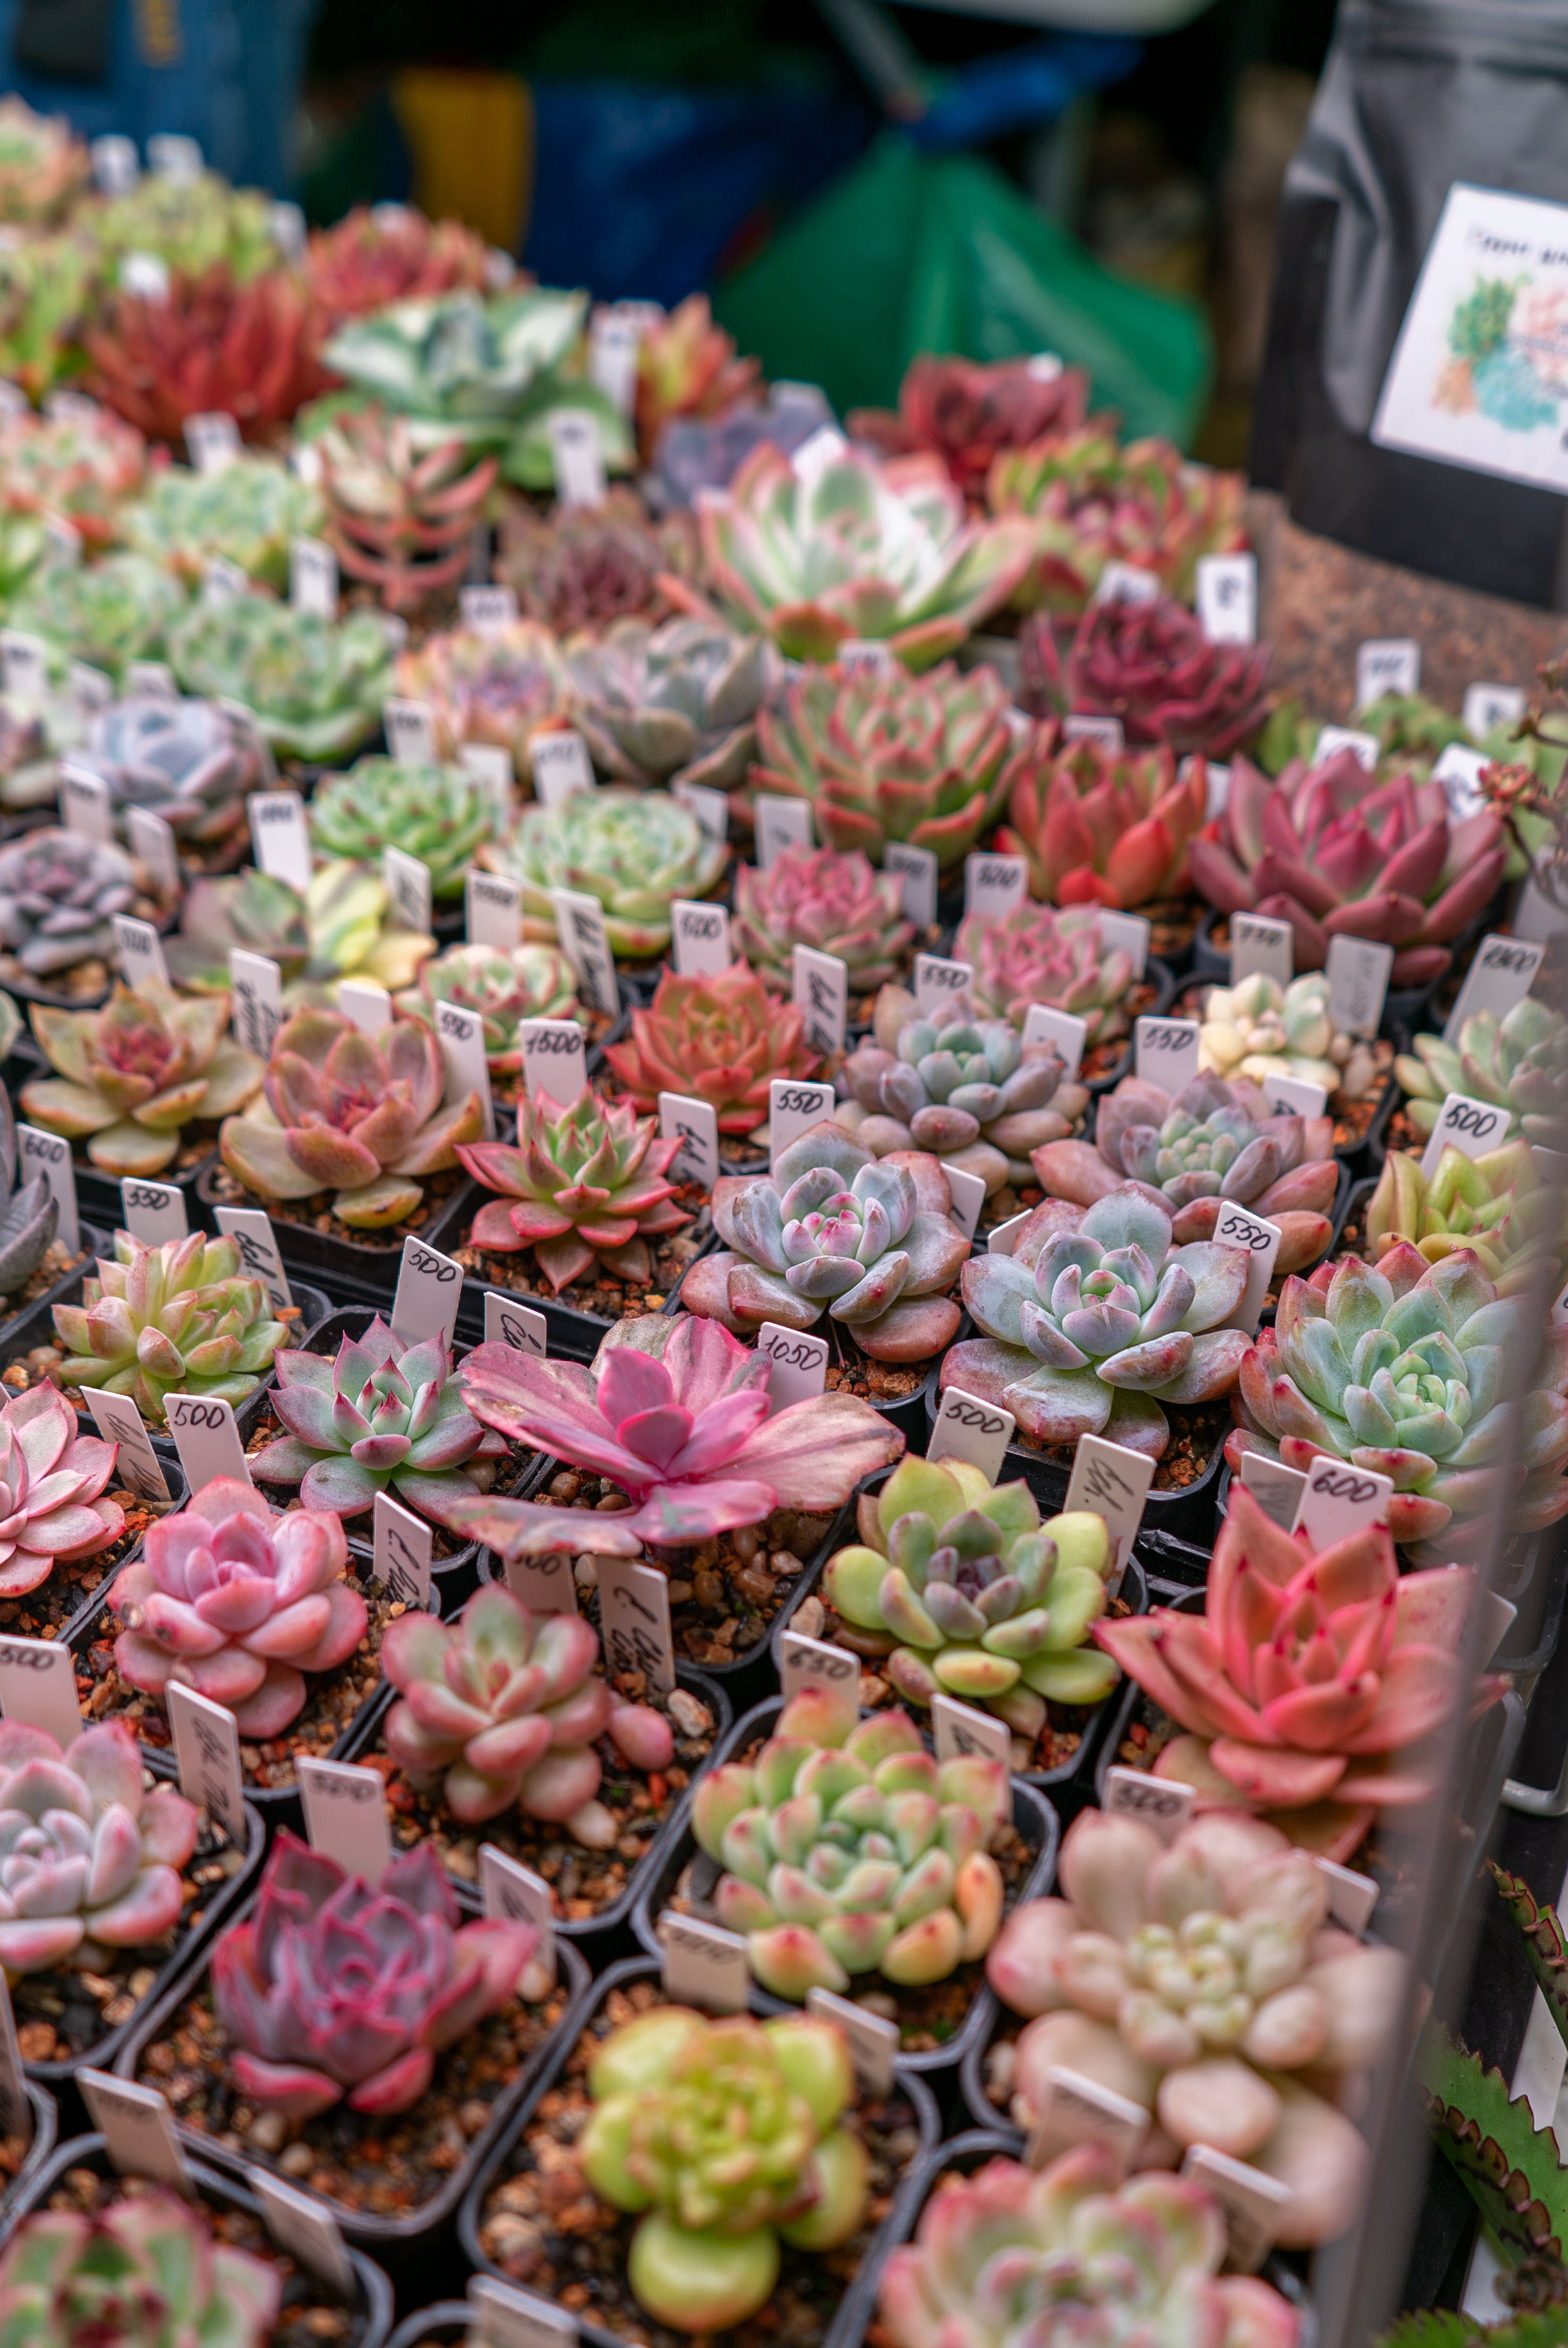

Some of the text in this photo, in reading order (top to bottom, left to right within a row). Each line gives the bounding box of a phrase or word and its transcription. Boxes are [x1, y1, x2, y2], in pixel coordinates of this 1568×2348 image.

[527, 1030, 582, 1055] 1500
[1142, 1026, 1194, 1052] 550
[776, 1090, 823, 1114] 550
[24, 1133, 65, 1163] 600
[127, 1187, 170, 1210] 550
[1221, 1216, 1272, 1251] 550
[409, 1249, 457, 1283] 500
[764, 1334, 823, 1371] 1050
[174, 1403, 225, 1430] 500
[945, 1401, 1006, 1434] 500
[1313, 1469, 1378, 1504] 600
[0, 1646, 56, 1673] 500
